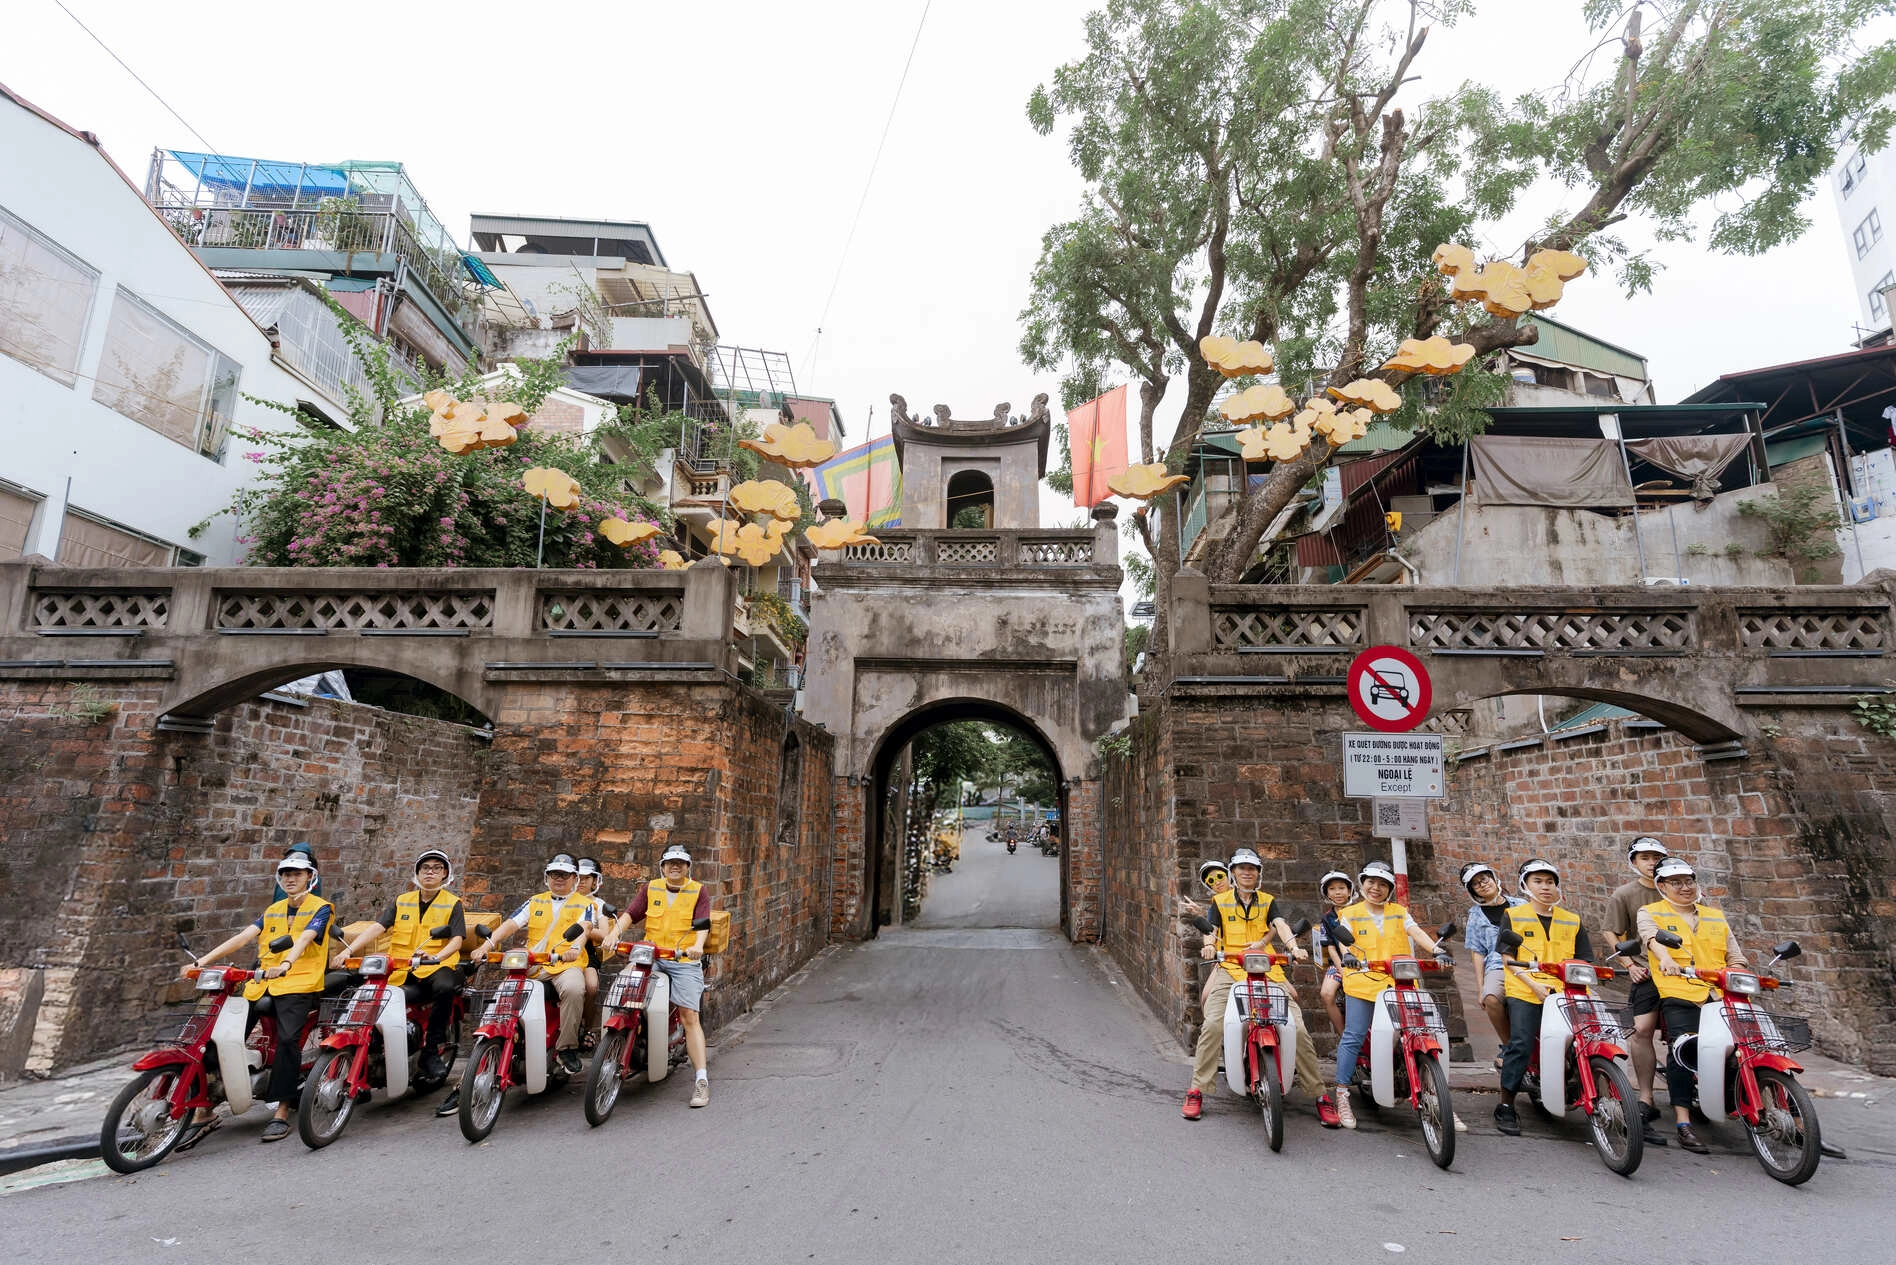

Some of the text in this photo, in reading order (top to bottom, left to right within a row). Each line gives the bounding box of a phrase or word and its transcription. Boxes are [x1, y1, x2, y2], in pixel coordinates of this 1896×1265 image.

[1348, 740, 1355, 748] XE
[1409, 742, 1423, 751] HOẠT
[1378, 768, 1412, 781] NGOẠI LỆ
[1381, 782, 1412, 793] Except
